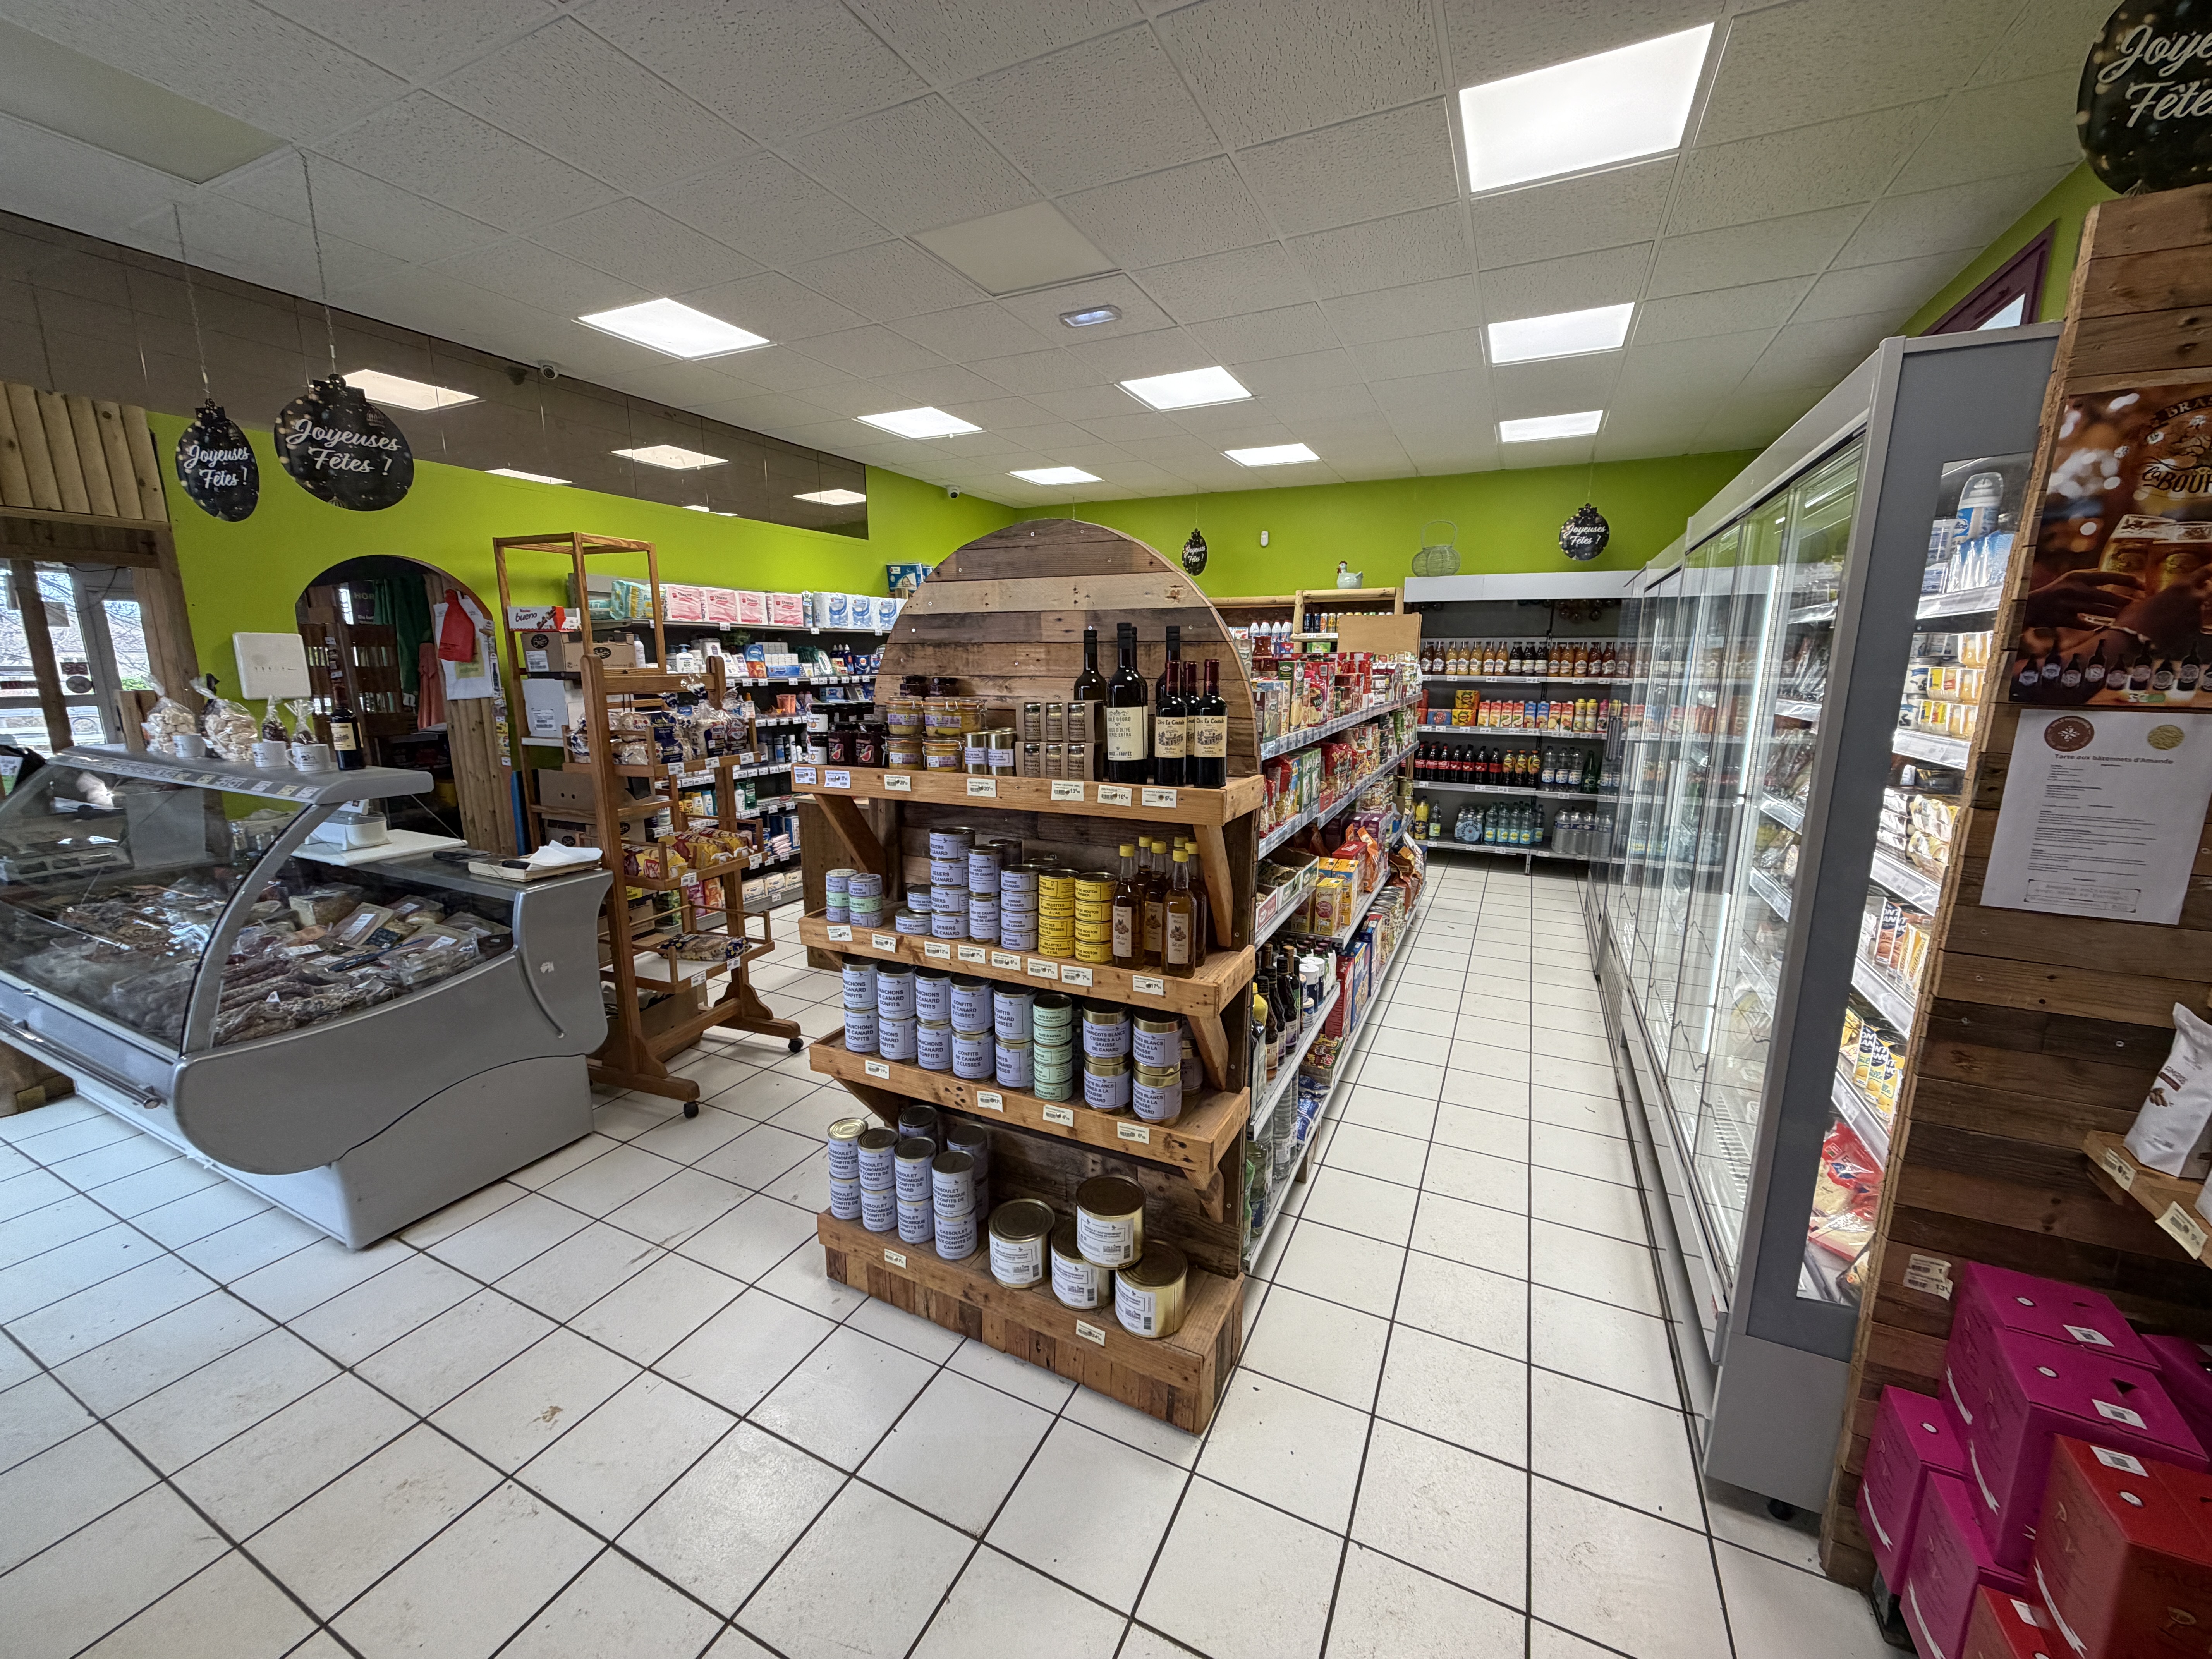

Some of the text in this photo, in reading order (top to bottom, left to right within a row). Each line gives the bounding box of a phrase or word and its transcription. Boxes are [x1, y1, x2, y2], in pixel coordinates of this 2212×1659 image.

[286, 419, 402, 452] Joyeuses
[184, 445, 250, 469] Joyeuses
[308, 448, 375, 474] Fêtes
[199, 468, 239, 488] Fêtes
[1563, 525, 1606, 536] Joyeuses
[1570, 536, 1593, 545] Fêtes
[1184, 546, 1206, 558] Joyeuses
[515, 613, 537, 622] bueno
[917, 1001, 936, 1009] CONFITS
[1137, 1051, 1154, 1060] CANARD
[1089, 1095, 1106, 1103] CANARD
[1137, 1106, 1154, 1114] CANARD
